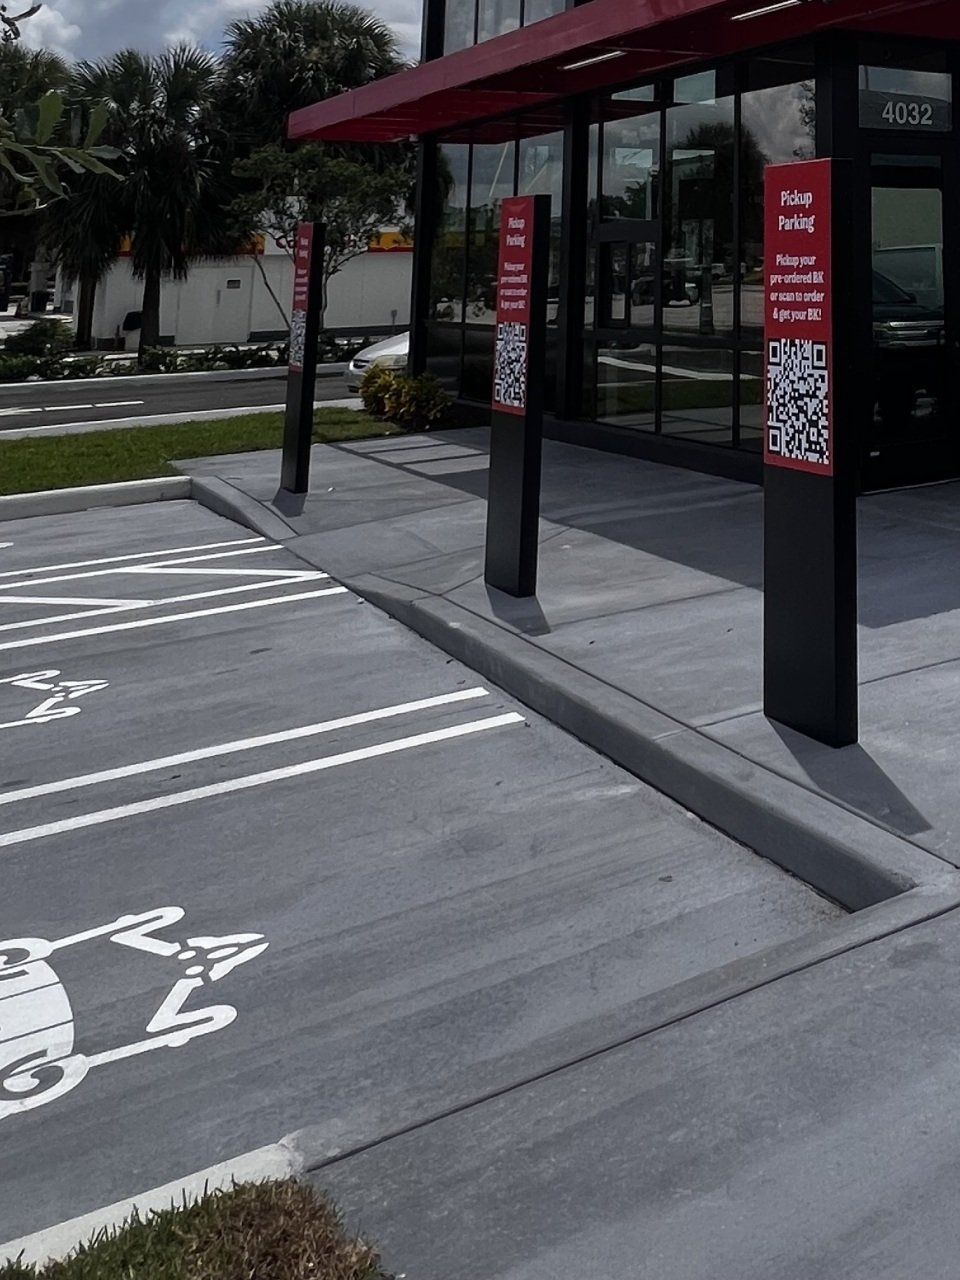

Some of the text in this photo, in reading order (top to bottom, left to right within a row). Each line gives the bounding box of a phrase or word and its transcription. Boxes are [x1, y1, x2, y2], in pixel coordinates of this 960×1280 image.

[881, 100, 933, 126] 4032
[780, 189, 813, 208] Pickup
[778, 213, 816, 234] Parking
[776, 254, 817, 268] Pickup your
[770, 271, 824, 286] pre-ordered BK
[770, 289, 825, 303] or scan to order
[773, 308, 822, 323] & get your BK!
